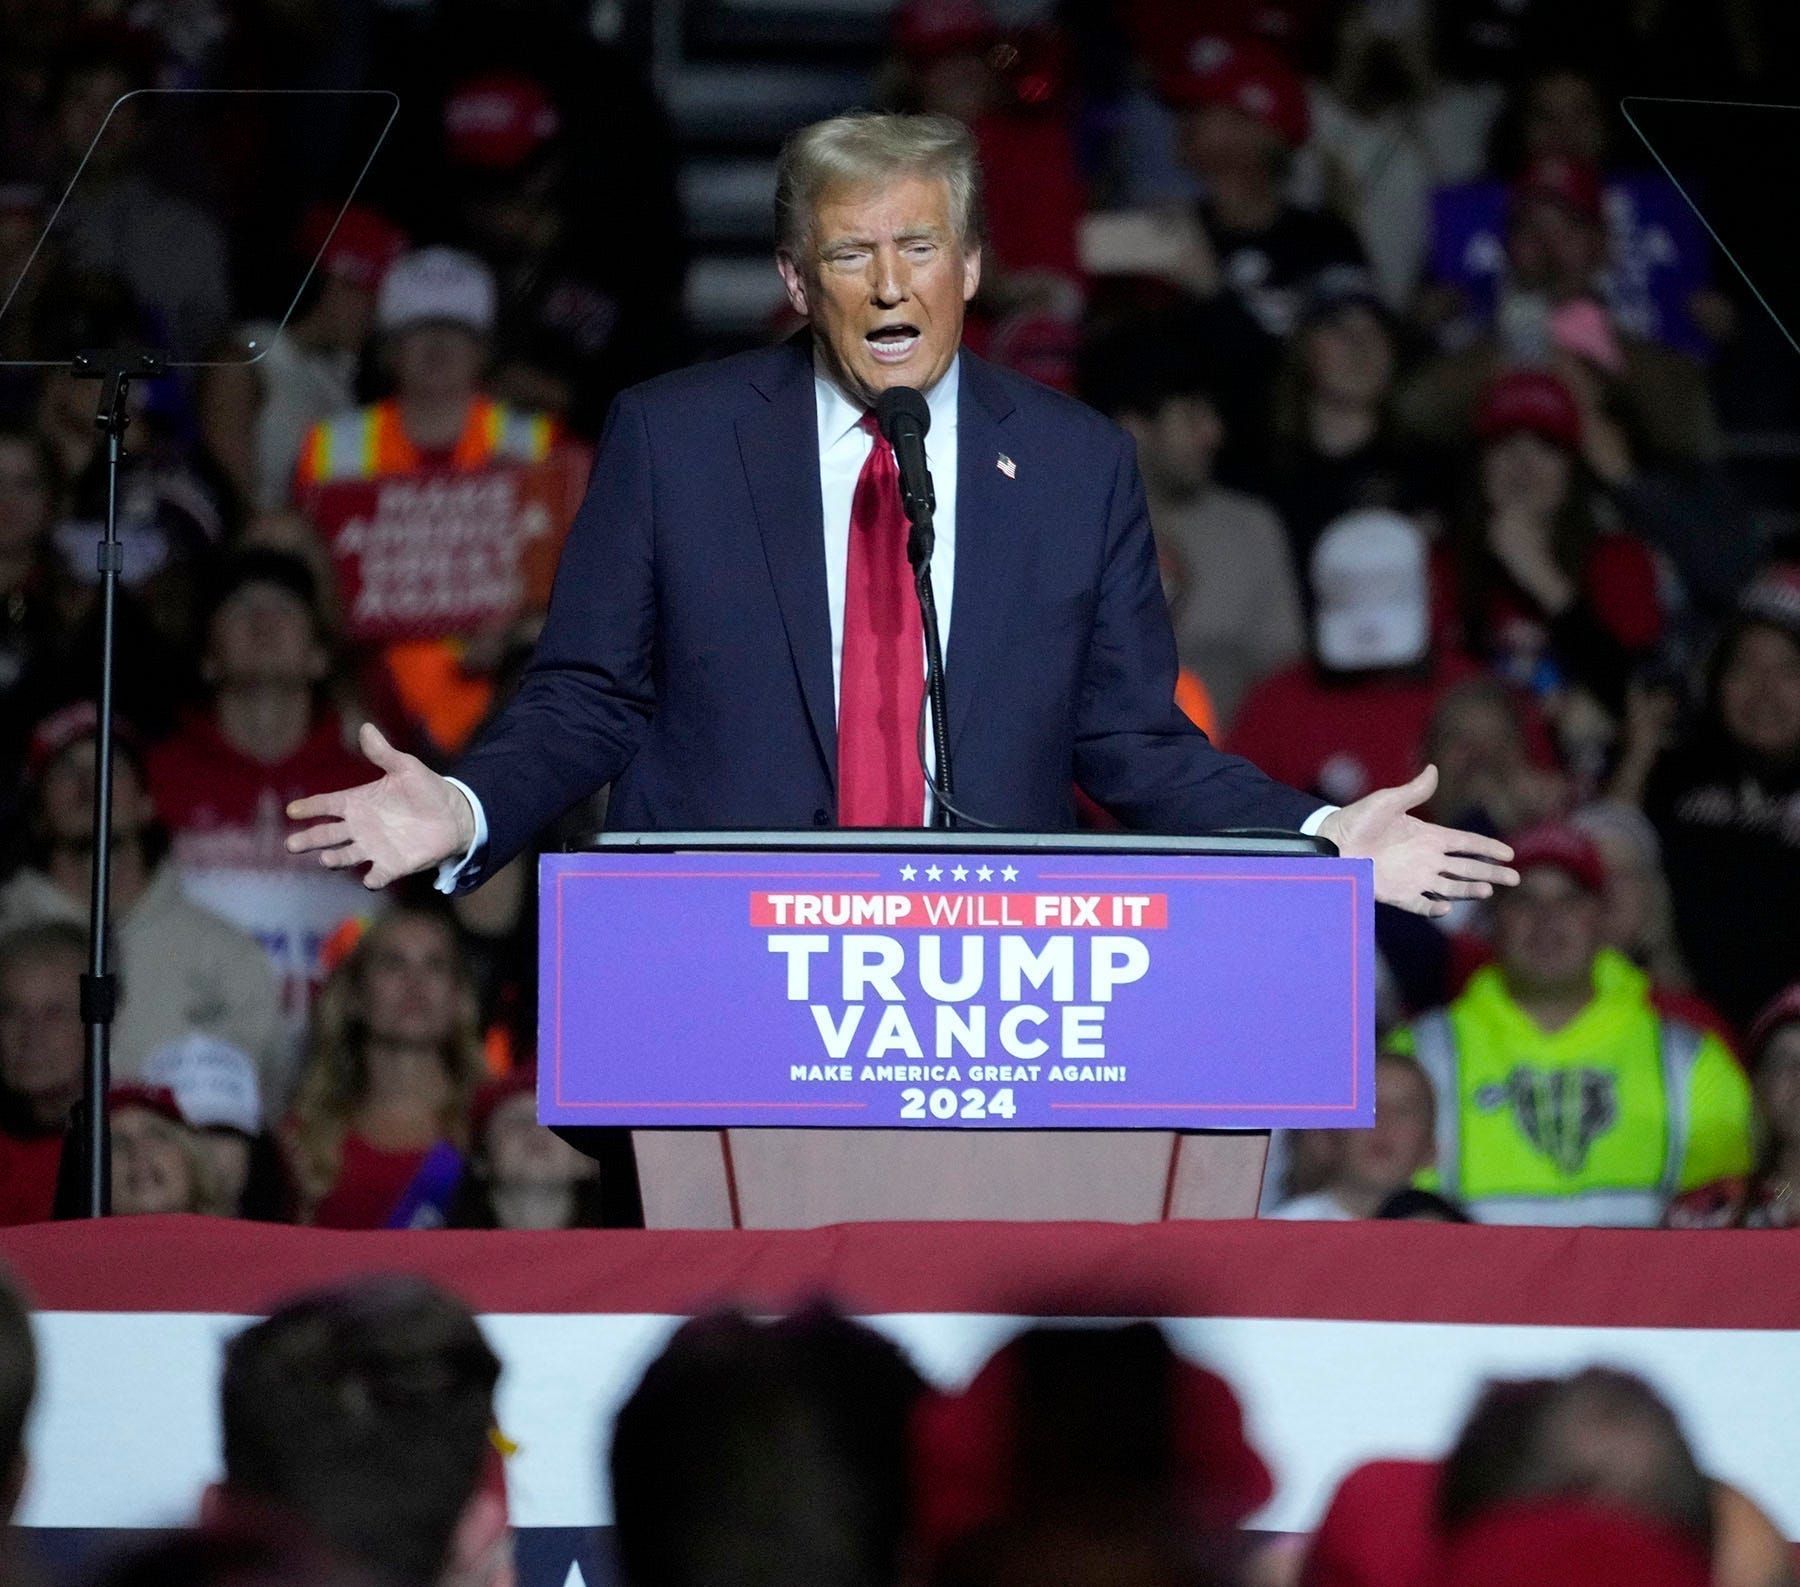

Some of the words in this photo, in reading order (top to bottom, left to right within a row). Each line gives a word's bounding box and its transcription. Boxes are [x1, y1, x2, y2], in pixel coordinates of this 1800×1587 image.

[767, 894, 912, 926] TRUMP
[922, 895, 1024, 926] WILL
[1035, 896, 1102, 927] FIX
[1112, 896, 1150, 927] IT
[767, 934, 1150, 1002] TRUMP
[810, 1004, 1106, 1060] VANCE
[790, 1064, 853, 1081] MAKE
[860, 1065, 962, 1082] AMERICA
[968, 1065, 1042, 1082] GREAT
[1047, 1065, 1126, 1082] AGAIN!
[900, 1087, 1017, 1119] 2024
